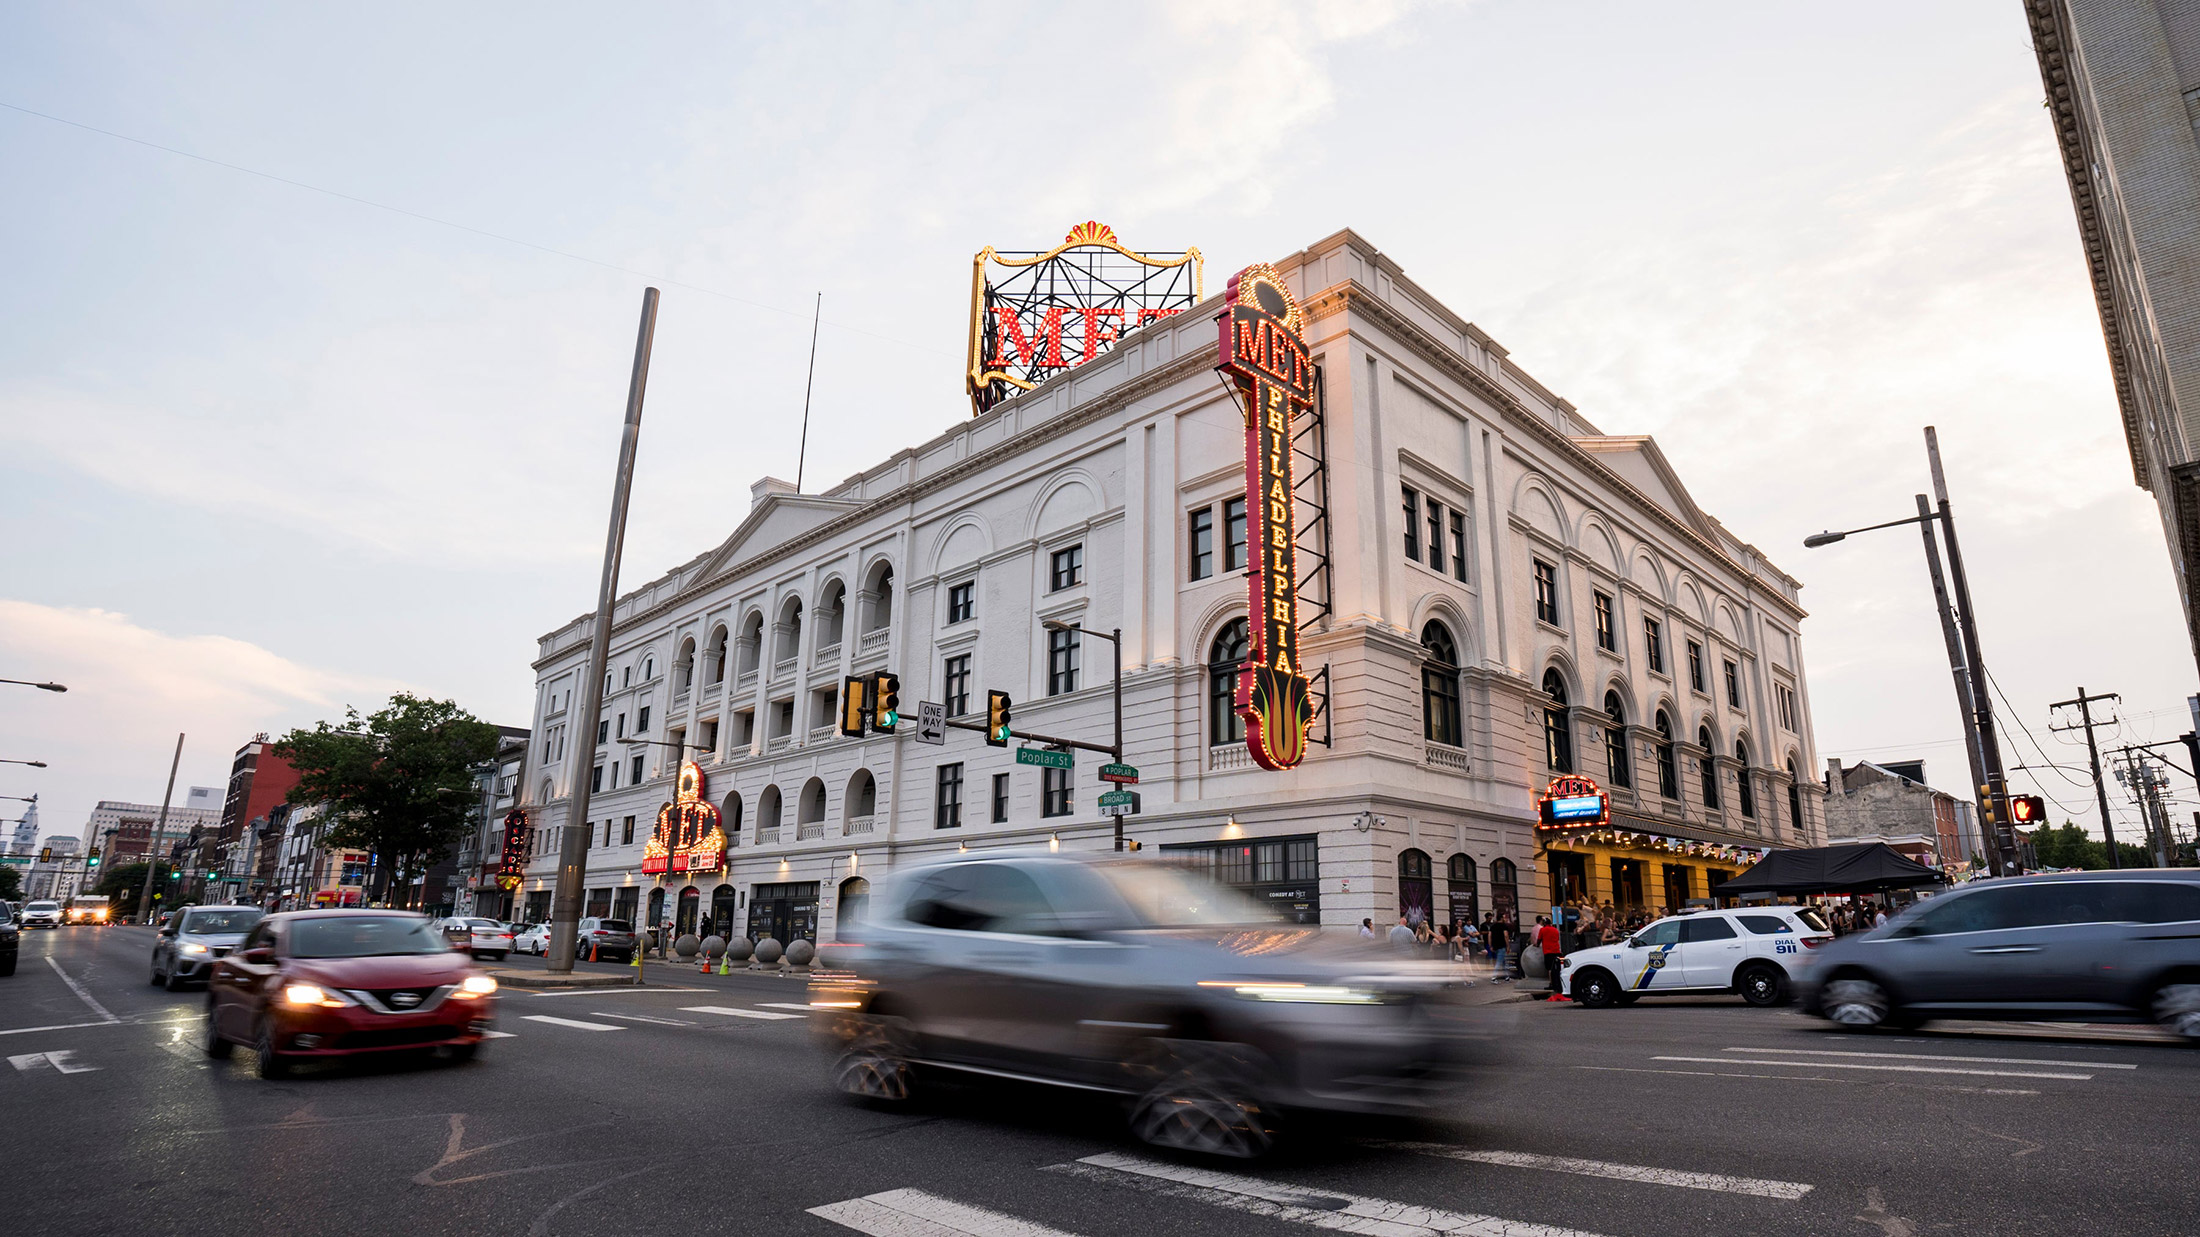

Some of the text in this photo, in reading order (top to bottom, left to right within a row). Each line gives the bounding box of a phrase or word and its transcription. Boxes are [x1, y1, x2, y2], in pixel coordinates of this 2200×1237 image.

[1237, 318, 1308, 391] MET
[1266, 385, 1292, 675] PHILADELPHIA
[923, 705, 942, 718] ONE
[922, 716, 942, 728] WAY
[1021, 751, 1068, 766] Poplar St
[1110, 767, 1132, 777] POPLAR
[1552, 779, 1590, 797] MET
[1104, 795, 1124, 804] BROAD
[1776, 945, 1797, 954] 911
